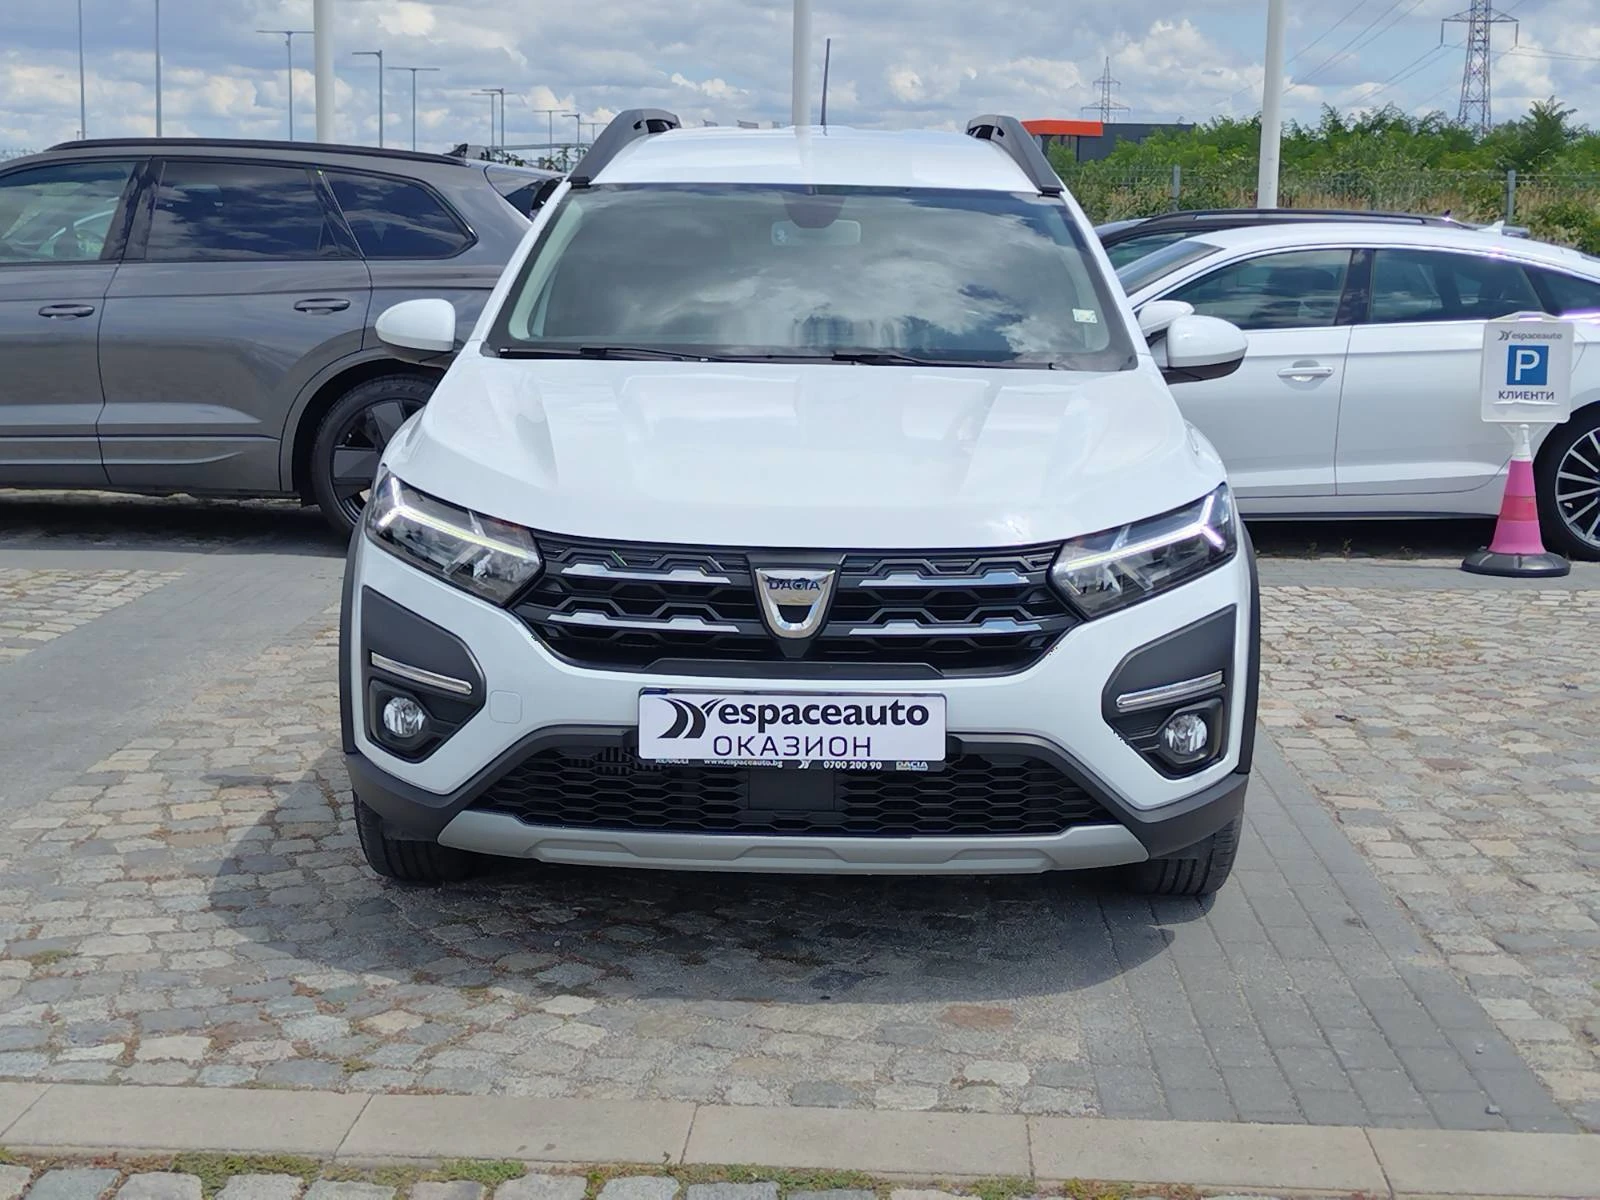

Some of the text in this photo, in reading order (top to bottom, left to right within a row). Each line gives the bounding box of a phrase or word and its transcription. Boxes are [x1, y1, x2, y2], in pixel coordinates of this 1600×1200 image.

[1514, 349, 1541, 381] P
[1498, 390, 1555, 401] КЛИЕНТИ
[717, 699, 930, 733] espaceauto
[713, 735, 872, 757] ОКАЗИОН
[823, 760, 883, 770] 0700 200 90
